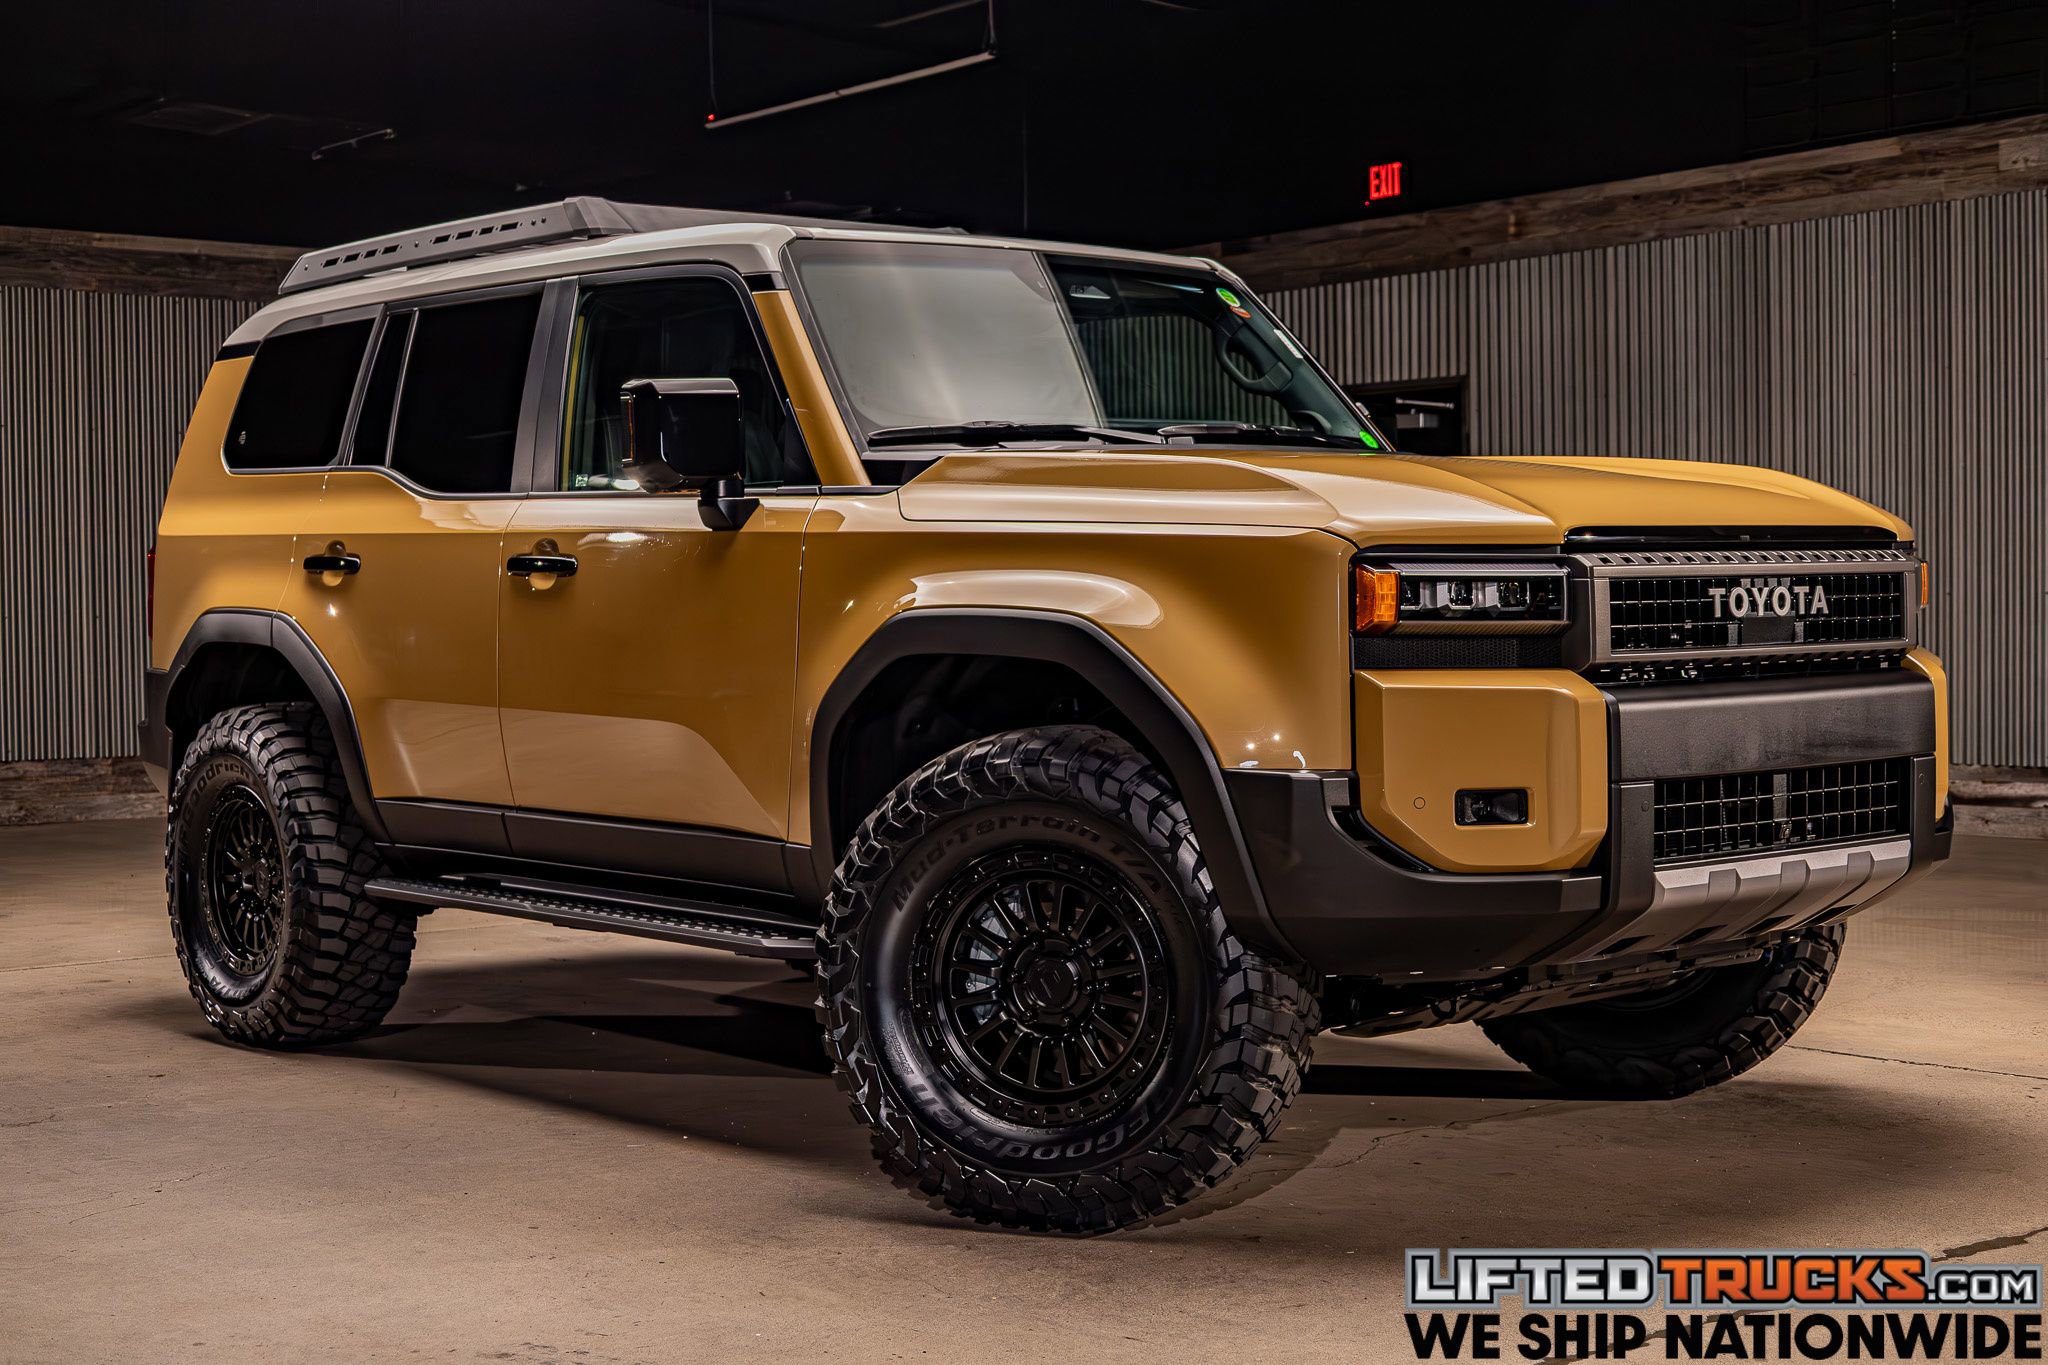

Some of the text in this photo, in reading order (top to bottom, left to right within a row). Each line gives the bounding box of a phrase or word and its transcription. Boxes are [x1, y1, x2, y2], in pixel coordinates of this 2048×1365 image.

[1370, 162, 1402, 200] EXIT
[1708, 585, 1829, 618] TOYOTA
[892, 814, 1101, 912] Mud-Terrain
